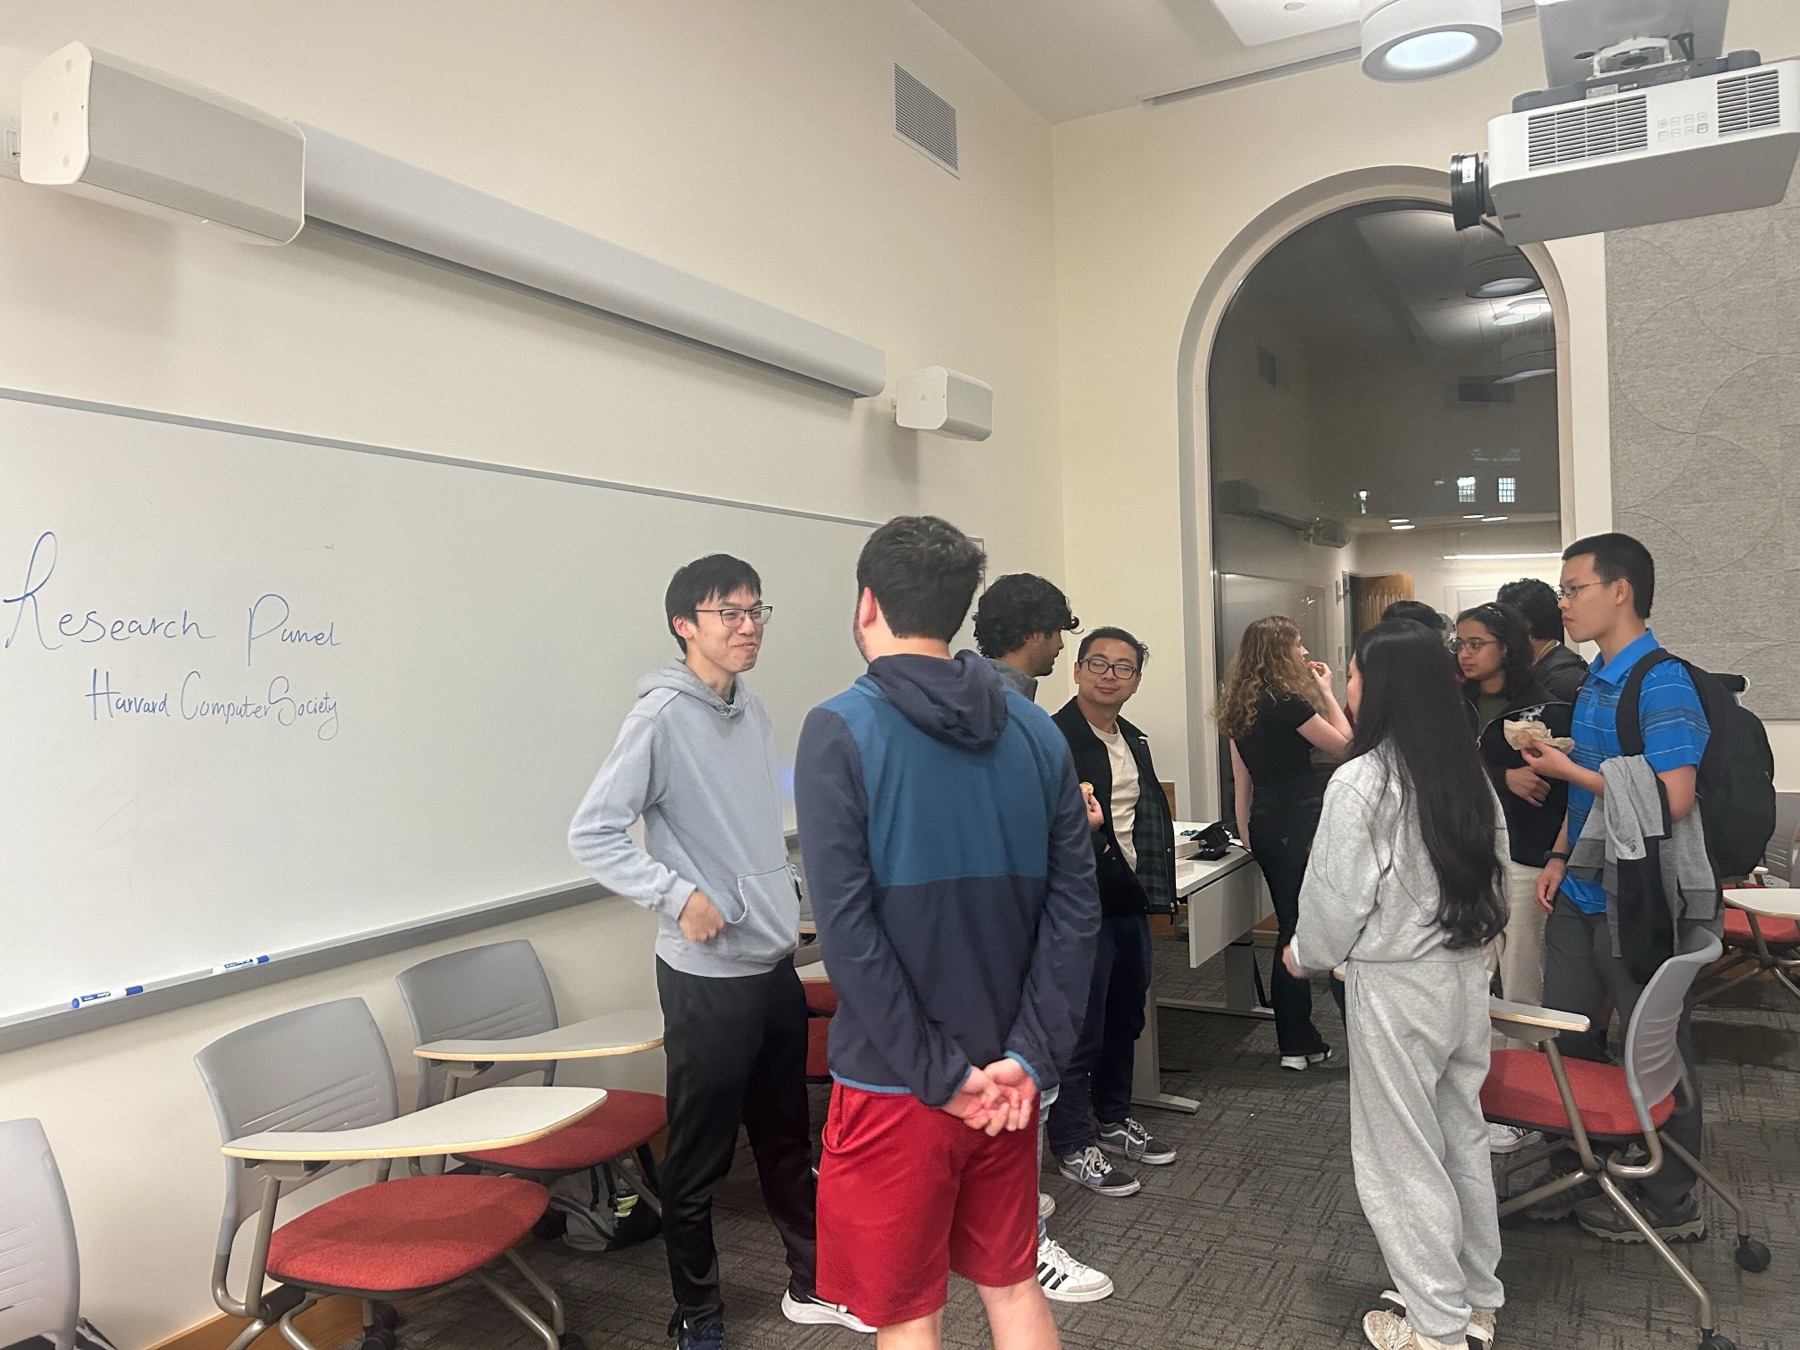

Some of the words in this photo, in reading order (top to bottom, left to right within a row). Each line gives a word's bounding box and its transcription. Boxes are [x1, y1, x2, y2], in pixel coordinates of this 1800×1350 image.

[2, 531, 216, 650] Research
[247, 593, 341, 666] Panel
[85, 668, 170, 721] Harvard
[180, 670, 270, 725] Computer
[268, 675, 339, 741] Society
